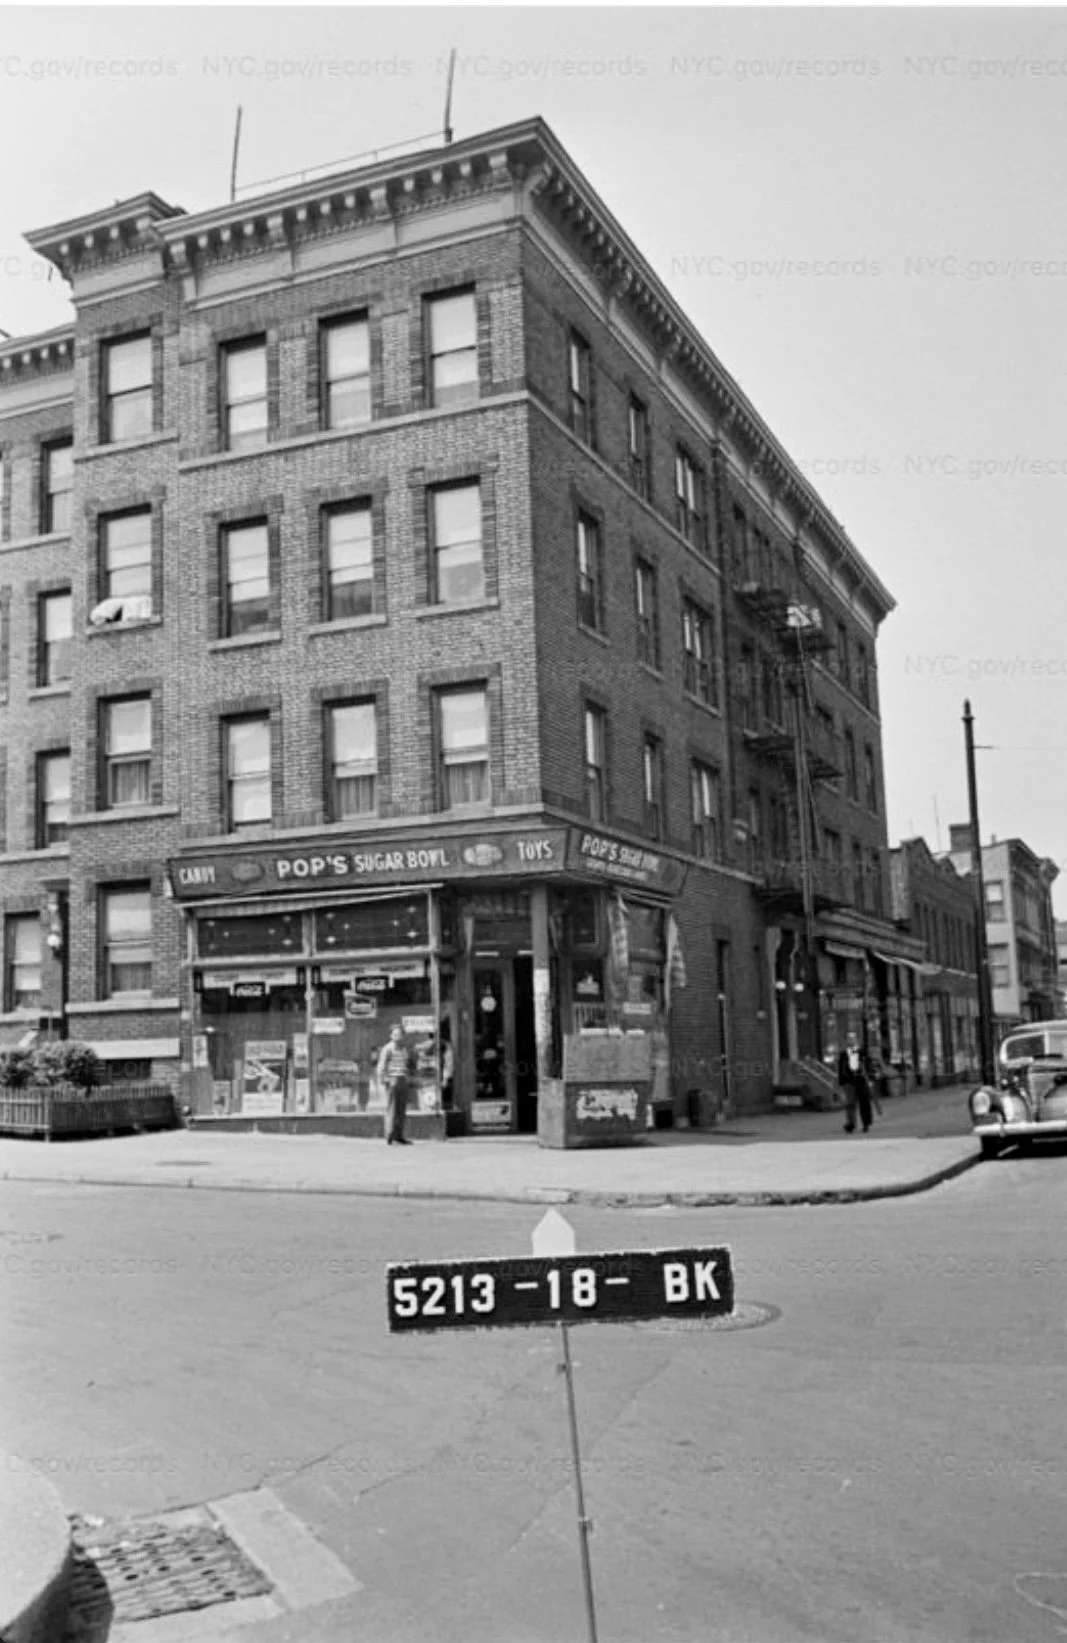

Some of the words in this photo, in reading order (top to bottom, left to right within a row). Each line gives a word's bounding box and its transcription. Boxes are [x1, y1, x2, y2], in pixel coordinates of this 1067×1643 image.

[277, 855, 349, 879] POP'S
[354, 851, 404, 873] SUGAR
[407, 848, 450, 869] BOWL
[517, 839, 553, 862] TOYS
[581, 834, 619, 861] POP'S
[393, 1273, 496, 1317] 5213
[663, 1260, 722, 1303] BK
